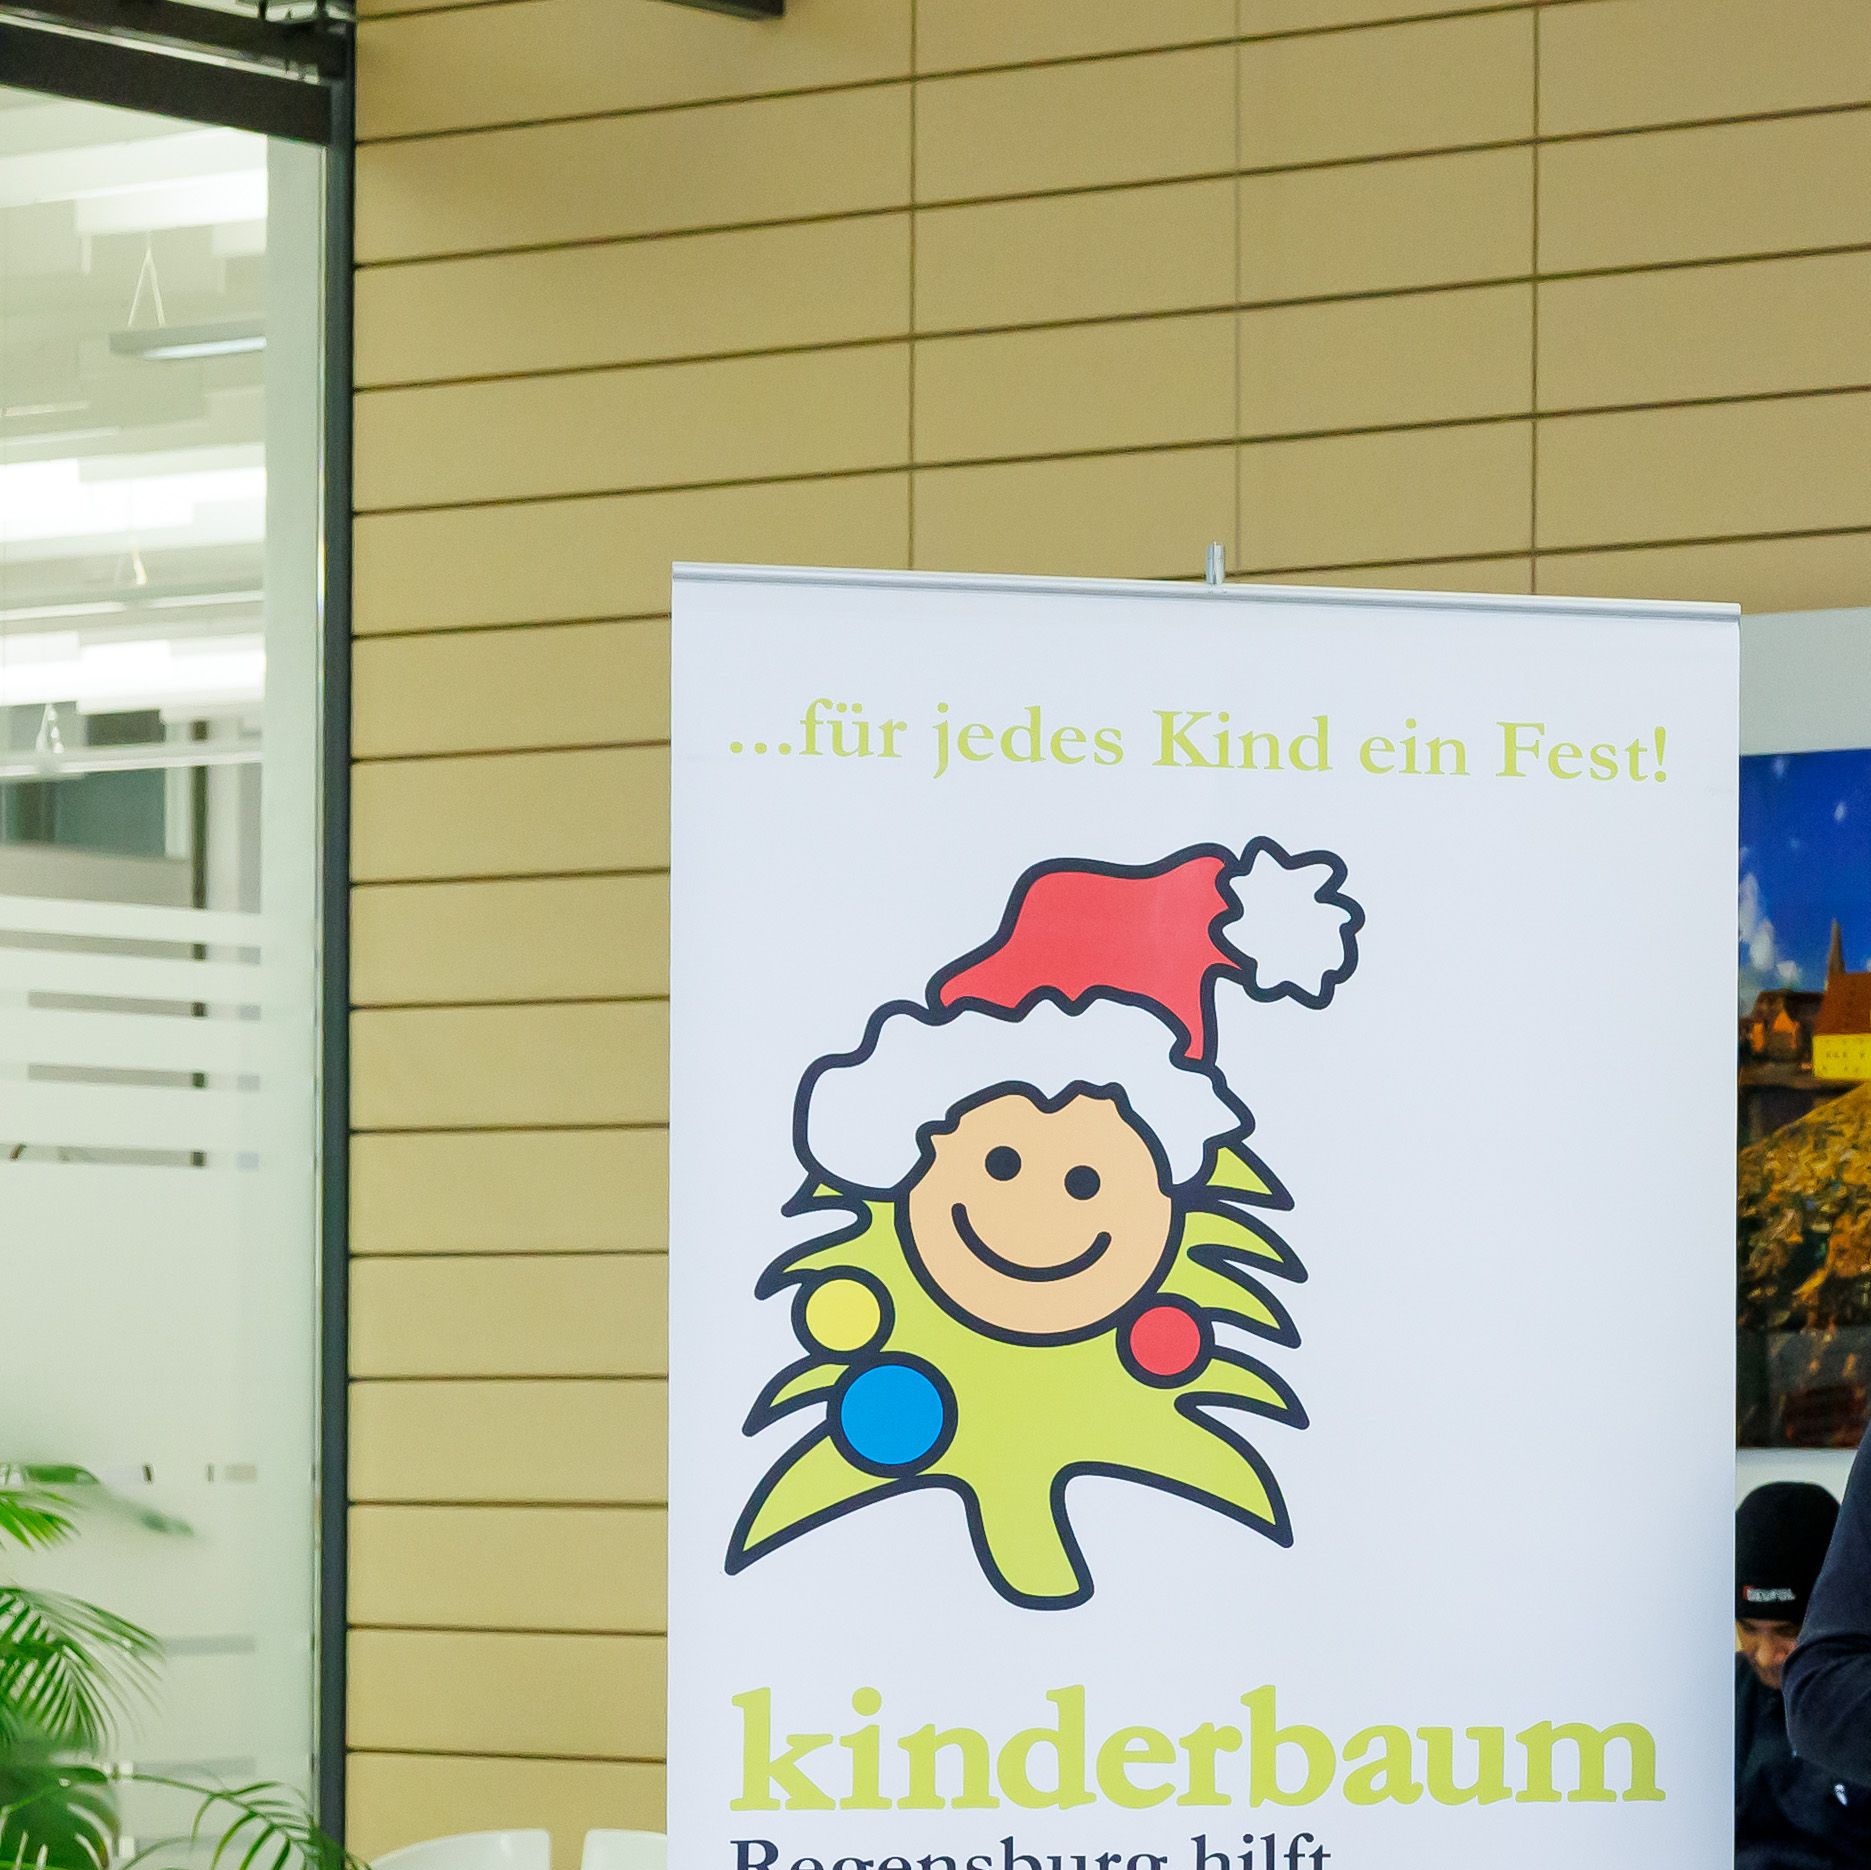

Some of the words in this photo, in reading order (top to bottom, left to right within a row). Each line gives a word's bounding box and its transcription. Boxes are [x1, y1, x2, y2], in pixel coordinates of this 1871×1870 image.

[729, 697, 908, 759] ...für
[934, 704, 1124, 778] jedes
[1152, 709, 1332, 775] Kind
[1360, 718, 1470, 776] ein
[1495, 722, 1669, 783] Fest!
[730, 1684, 1665, 1811] kinderbaum
